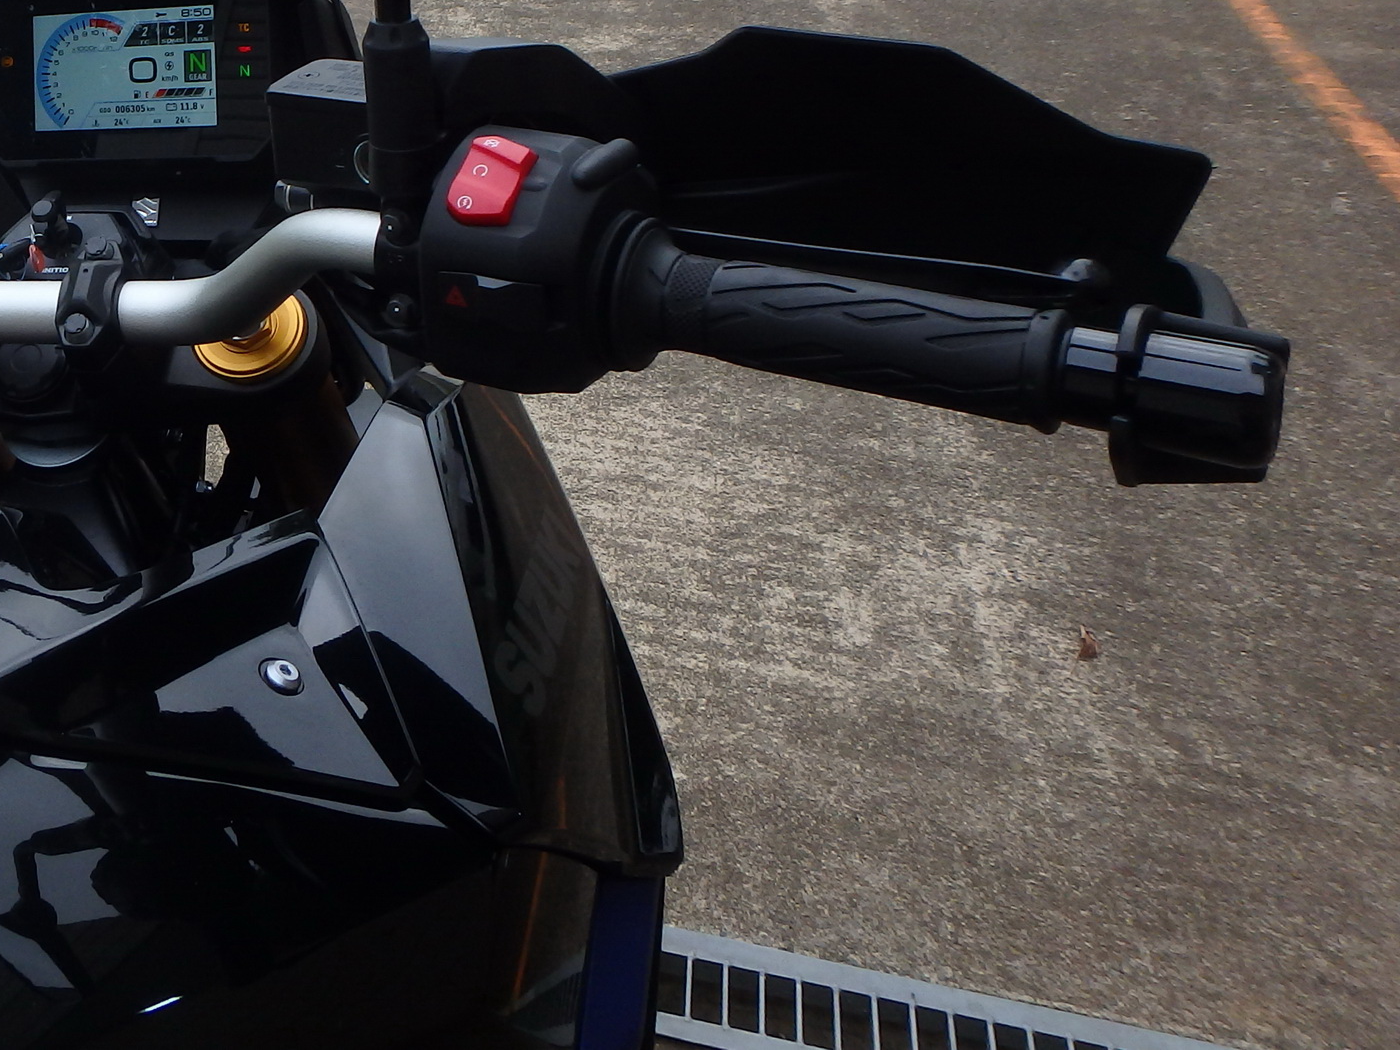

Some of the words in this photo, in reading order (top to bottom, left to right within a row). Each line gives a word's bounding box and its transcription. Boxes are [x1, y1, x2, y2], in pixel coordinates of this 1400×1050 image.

[181, 7, 212, 17] 8:50
[142, 26, 149, 37] 2
[168, 25, 176, 36] C
[197, 23, 204, 35] 2
[238, 23, 250, 32] TC
[189, 52, 206, 72] N
[129, 57, 158, 83] 0
[239, 64, 250, 77] N
[115, 104, 146, 114] 006305
[180, 102, 199, 111] 11.8
[494, 504, 585, 718] SUZUKI
